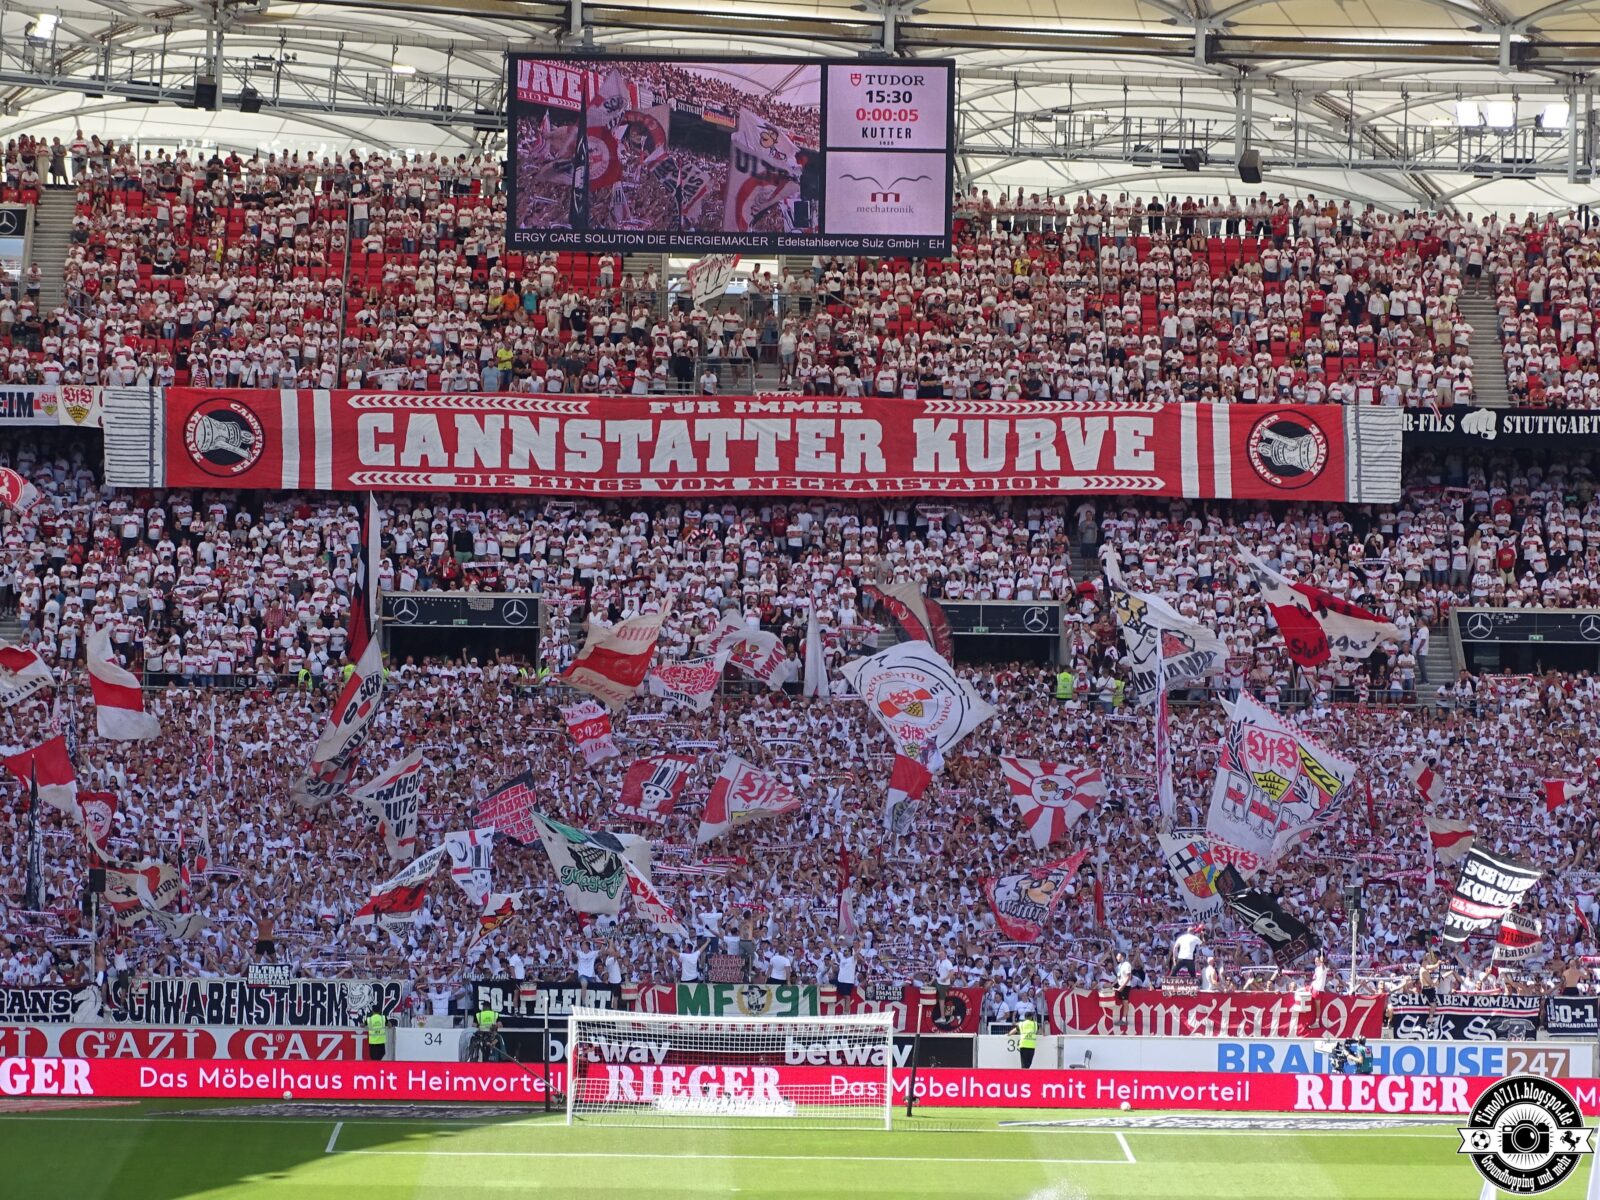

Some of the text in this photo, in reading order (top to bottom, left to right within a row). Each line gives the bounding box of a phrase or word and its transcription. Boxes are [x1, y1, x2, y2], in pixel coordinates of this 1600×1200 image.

[866, 74, 925, 86] TUDOR
[866, 90, 913, 104] 15:30
[856, 108, 919, 122] 0:00:05
[862, 127, 912, 139] KUTTER
[856, 204, 914, 214] mechatronik
[514, 233, 945, 249] ERGY CARE SOLUTION DIE ENERGIEMAKLER Edelstahlservice Sulz GmbH EH
[649, 401, 863, 414] FÜR IMMER
[1503, 415, 1600, 434] STUTTGART
[357, 412, 1155, 474] CANNSTATTER KURVE
[454, 474, 1060, 491] DIE KINGS VOM NECKARSTADION
[1247, 730, 1299, 768] VfB
[1505, 912, 1537, 930] SEKTION
[1499, 946, 1536, 958] VERBOT
[248, 965, 289, 974] ULTRAS
[677, 983, 735, 1016] MF
[775, 983, 819, 1017] 91
[1472, 995, 1540, 1009] KOMPANIE
[1321, 998, 1377, 1038] 97
[424, 1032, 442, 1046] 34
[785, 1037, 913, 1068] betway
[1218, 1042, 1566, 1077] BRAIHOUSE 247
[140, 1066, 562, 1092] Das Möbelhaus mit Heimvorteil
[606, 1065, 781, 1102] RIEGER
[831, 1075, 1250, 1103] Das Möbelhaus mit Heimvorteil
[1294, 1074, 1471, 1113] RIEGER
